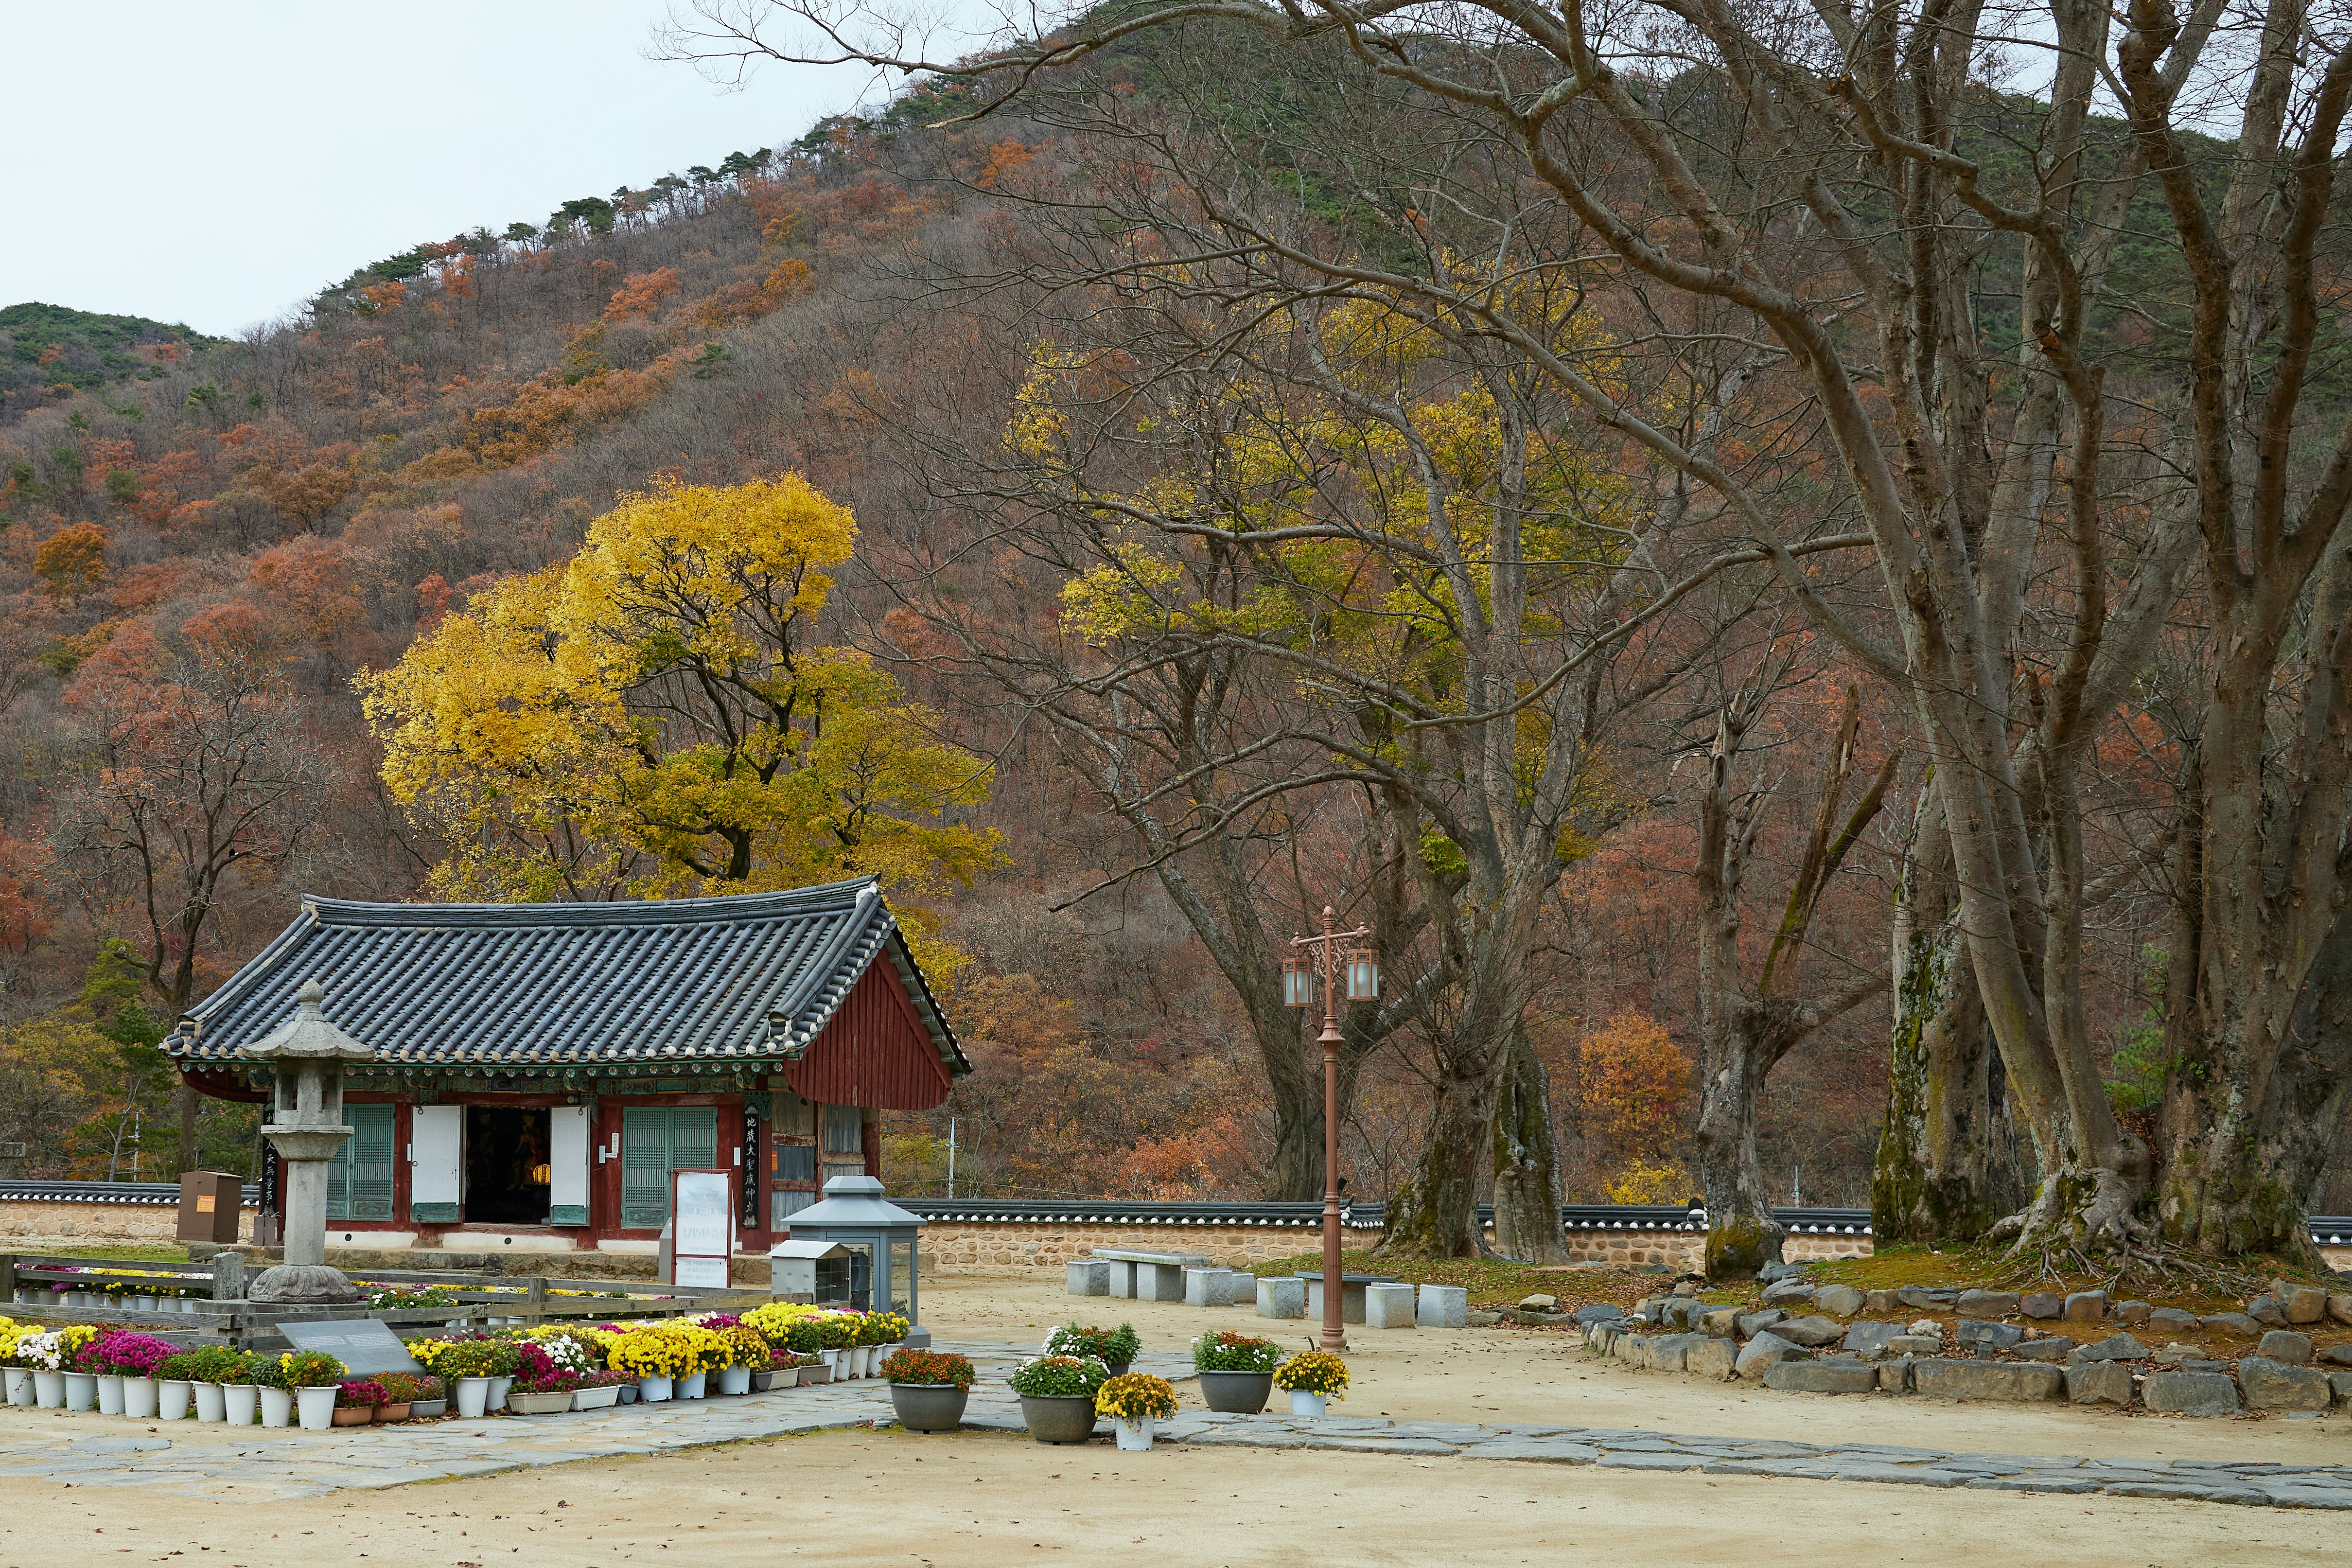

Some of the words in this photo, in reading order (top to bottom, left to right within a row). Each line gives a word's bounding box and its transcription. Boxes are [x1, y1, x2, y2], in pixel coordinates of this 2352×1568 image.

[265, 1113, 277, 1204] 利人天無量事
[745, 1117, 756, 1213] 地藏大聖威神力
